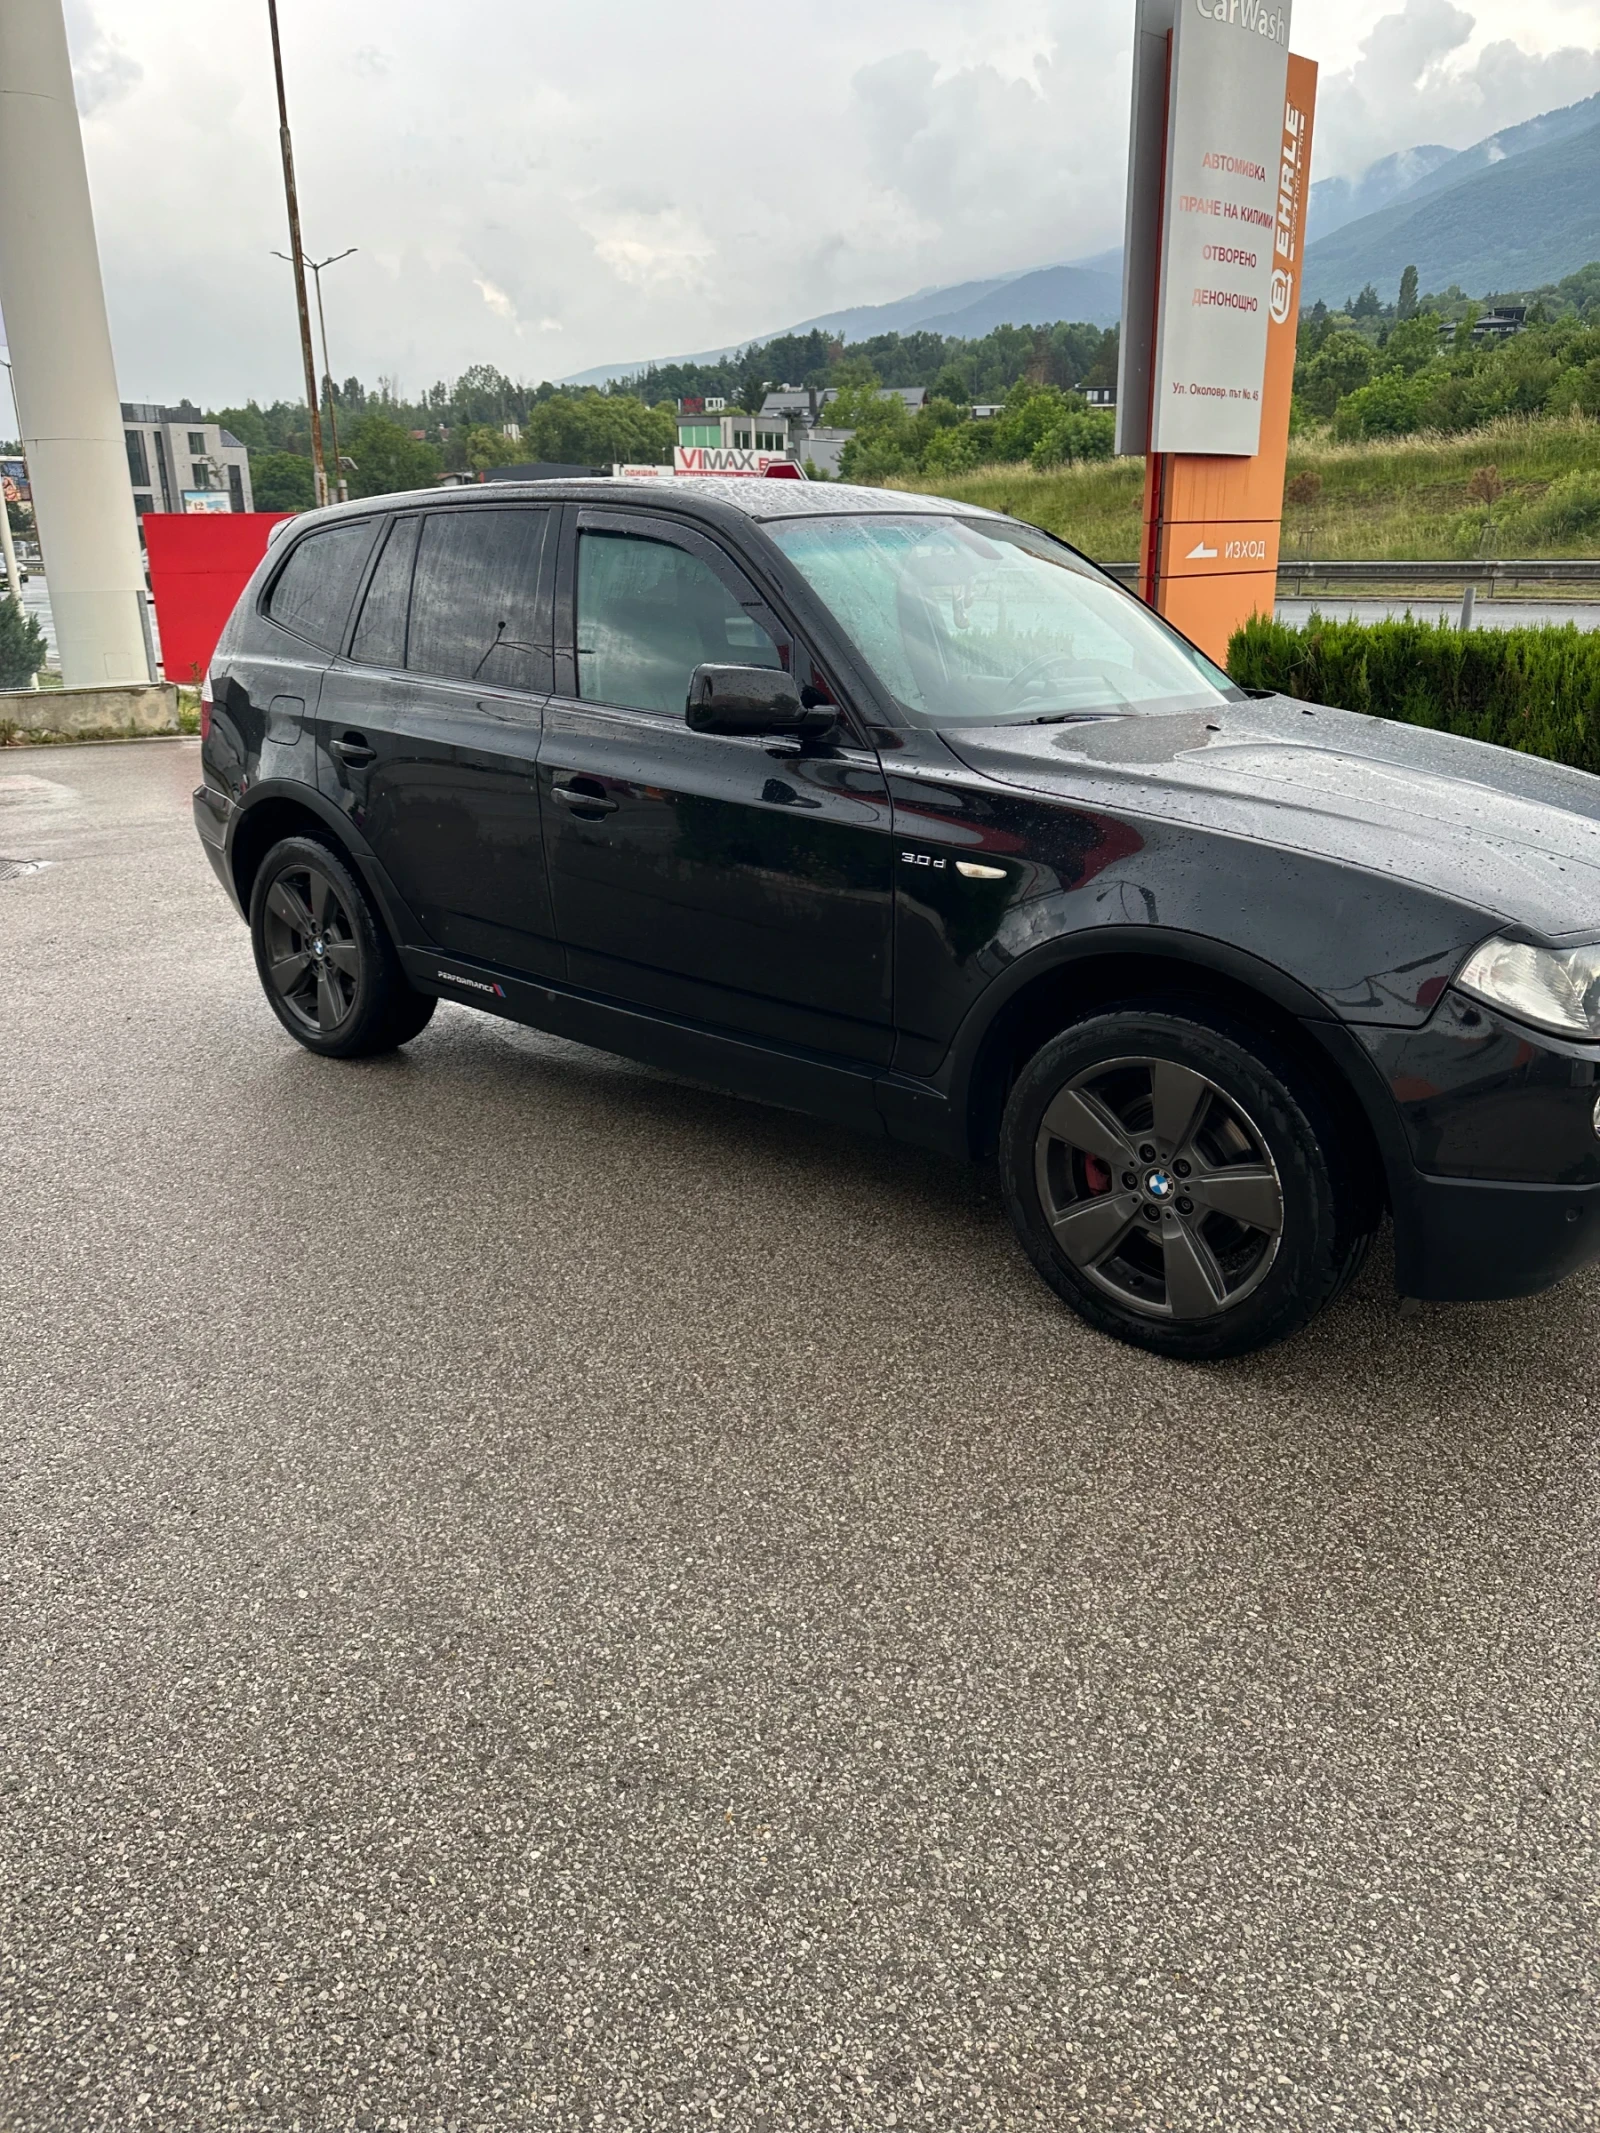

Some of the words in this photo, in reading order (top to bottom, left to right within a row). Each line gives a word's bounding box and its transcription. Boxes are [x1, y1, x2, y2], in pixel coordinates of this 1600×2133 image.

[1196, 0, 1285, 46] CarWash
[1202, 152, 1266, 182] АВТОМИВКА
[1276, 101, 1299, 258] EHRLE
[1179, 195, 1222, 216] ПРАНЕ
[1223, 202, 1238, 219] НА
[1240, 206, 1274, 230] КИЛИМИ
[1203, 244, 1257, 268] ОТВОРЕНО
[1192, 288, 1258, 312] ДЕНОНОЩНО
[1173, 382, 1187, 394] Ул.
[1190, 383, 1227, 399] Околовр.
[1229, 388, 1241, 398] път
[1252, 390, 1259, 401] 45
[679, 448, 782, 471] VIMAX.B
[1225, 540, 1265, 560] ИЗХОД
[437, 970, 495, 993] PERFORMANCE
